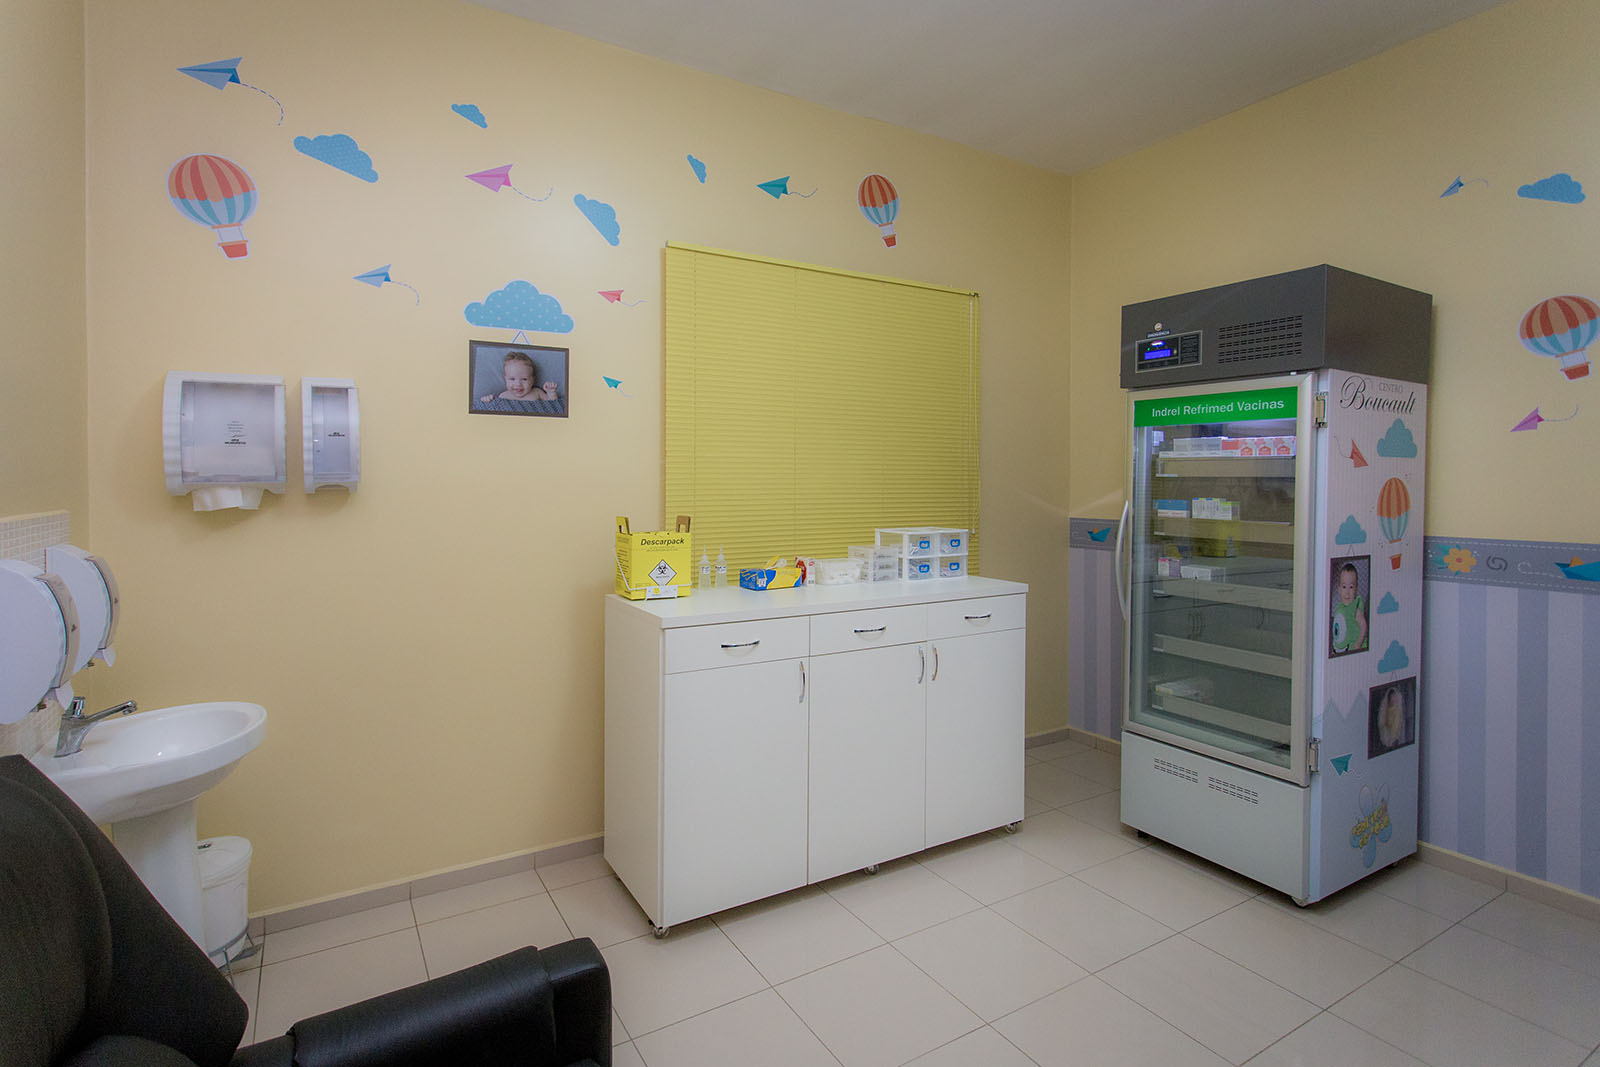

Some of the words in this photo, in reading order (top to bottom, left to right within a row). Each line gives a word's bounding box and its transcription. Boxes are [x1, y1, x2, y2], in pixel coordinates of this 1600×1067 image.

[1340, 375, 1416, 415] Boucault
[1152, 406, 1181, 418] Indrel
[1183, 402, 1234, 416] Refrimed
[1237, 400, 1285, 412] Vacinas
[640, 538, 685, 546] Descarpack
